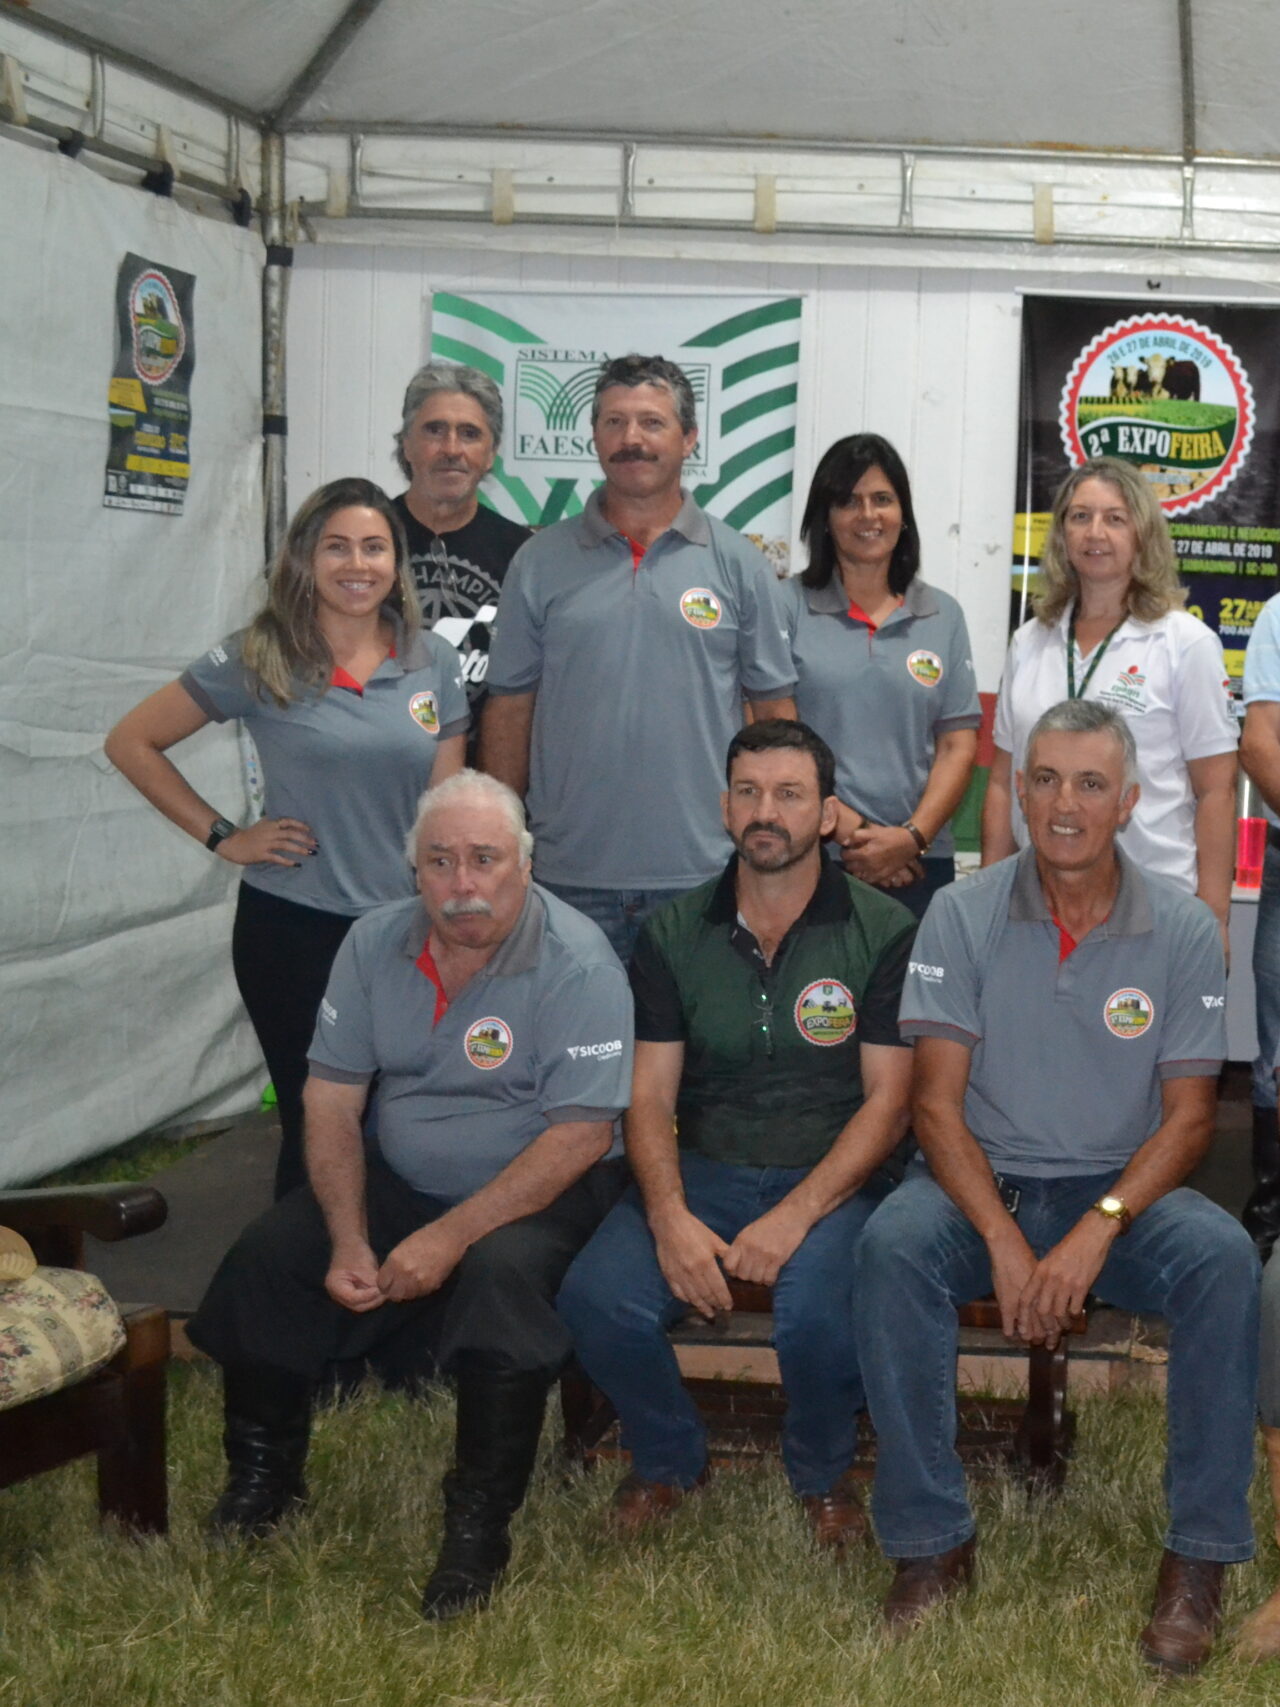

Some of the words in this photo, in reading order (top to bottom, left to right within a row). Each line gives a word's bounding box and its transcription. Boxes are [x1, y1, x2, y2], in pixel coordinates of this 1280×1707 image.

[1127, 341, 1138, 353] 27
[1139, 338, 1150, 348] DE
[1152, 336, 1178, 349] ABRIL
[1179, 341, 1189, 353] DE
[1190, 347, 1213, 368] 2019
[1088, 428, 1110, 457] 2ª
[1117, 426, 1226, 460] EXPOFEIRA
[1177, 540, 1190, 554] 27
[1191, 541, 1203, 555] DE
[1205, 541, 1232, 556] ABRIL
[1233, 543, 1246, 558] DE
[1247, 543, 1273, 558] 2019
[1219, 597, 1247, 619] 27
[580, 1040, 622, 1057] SICOOB
